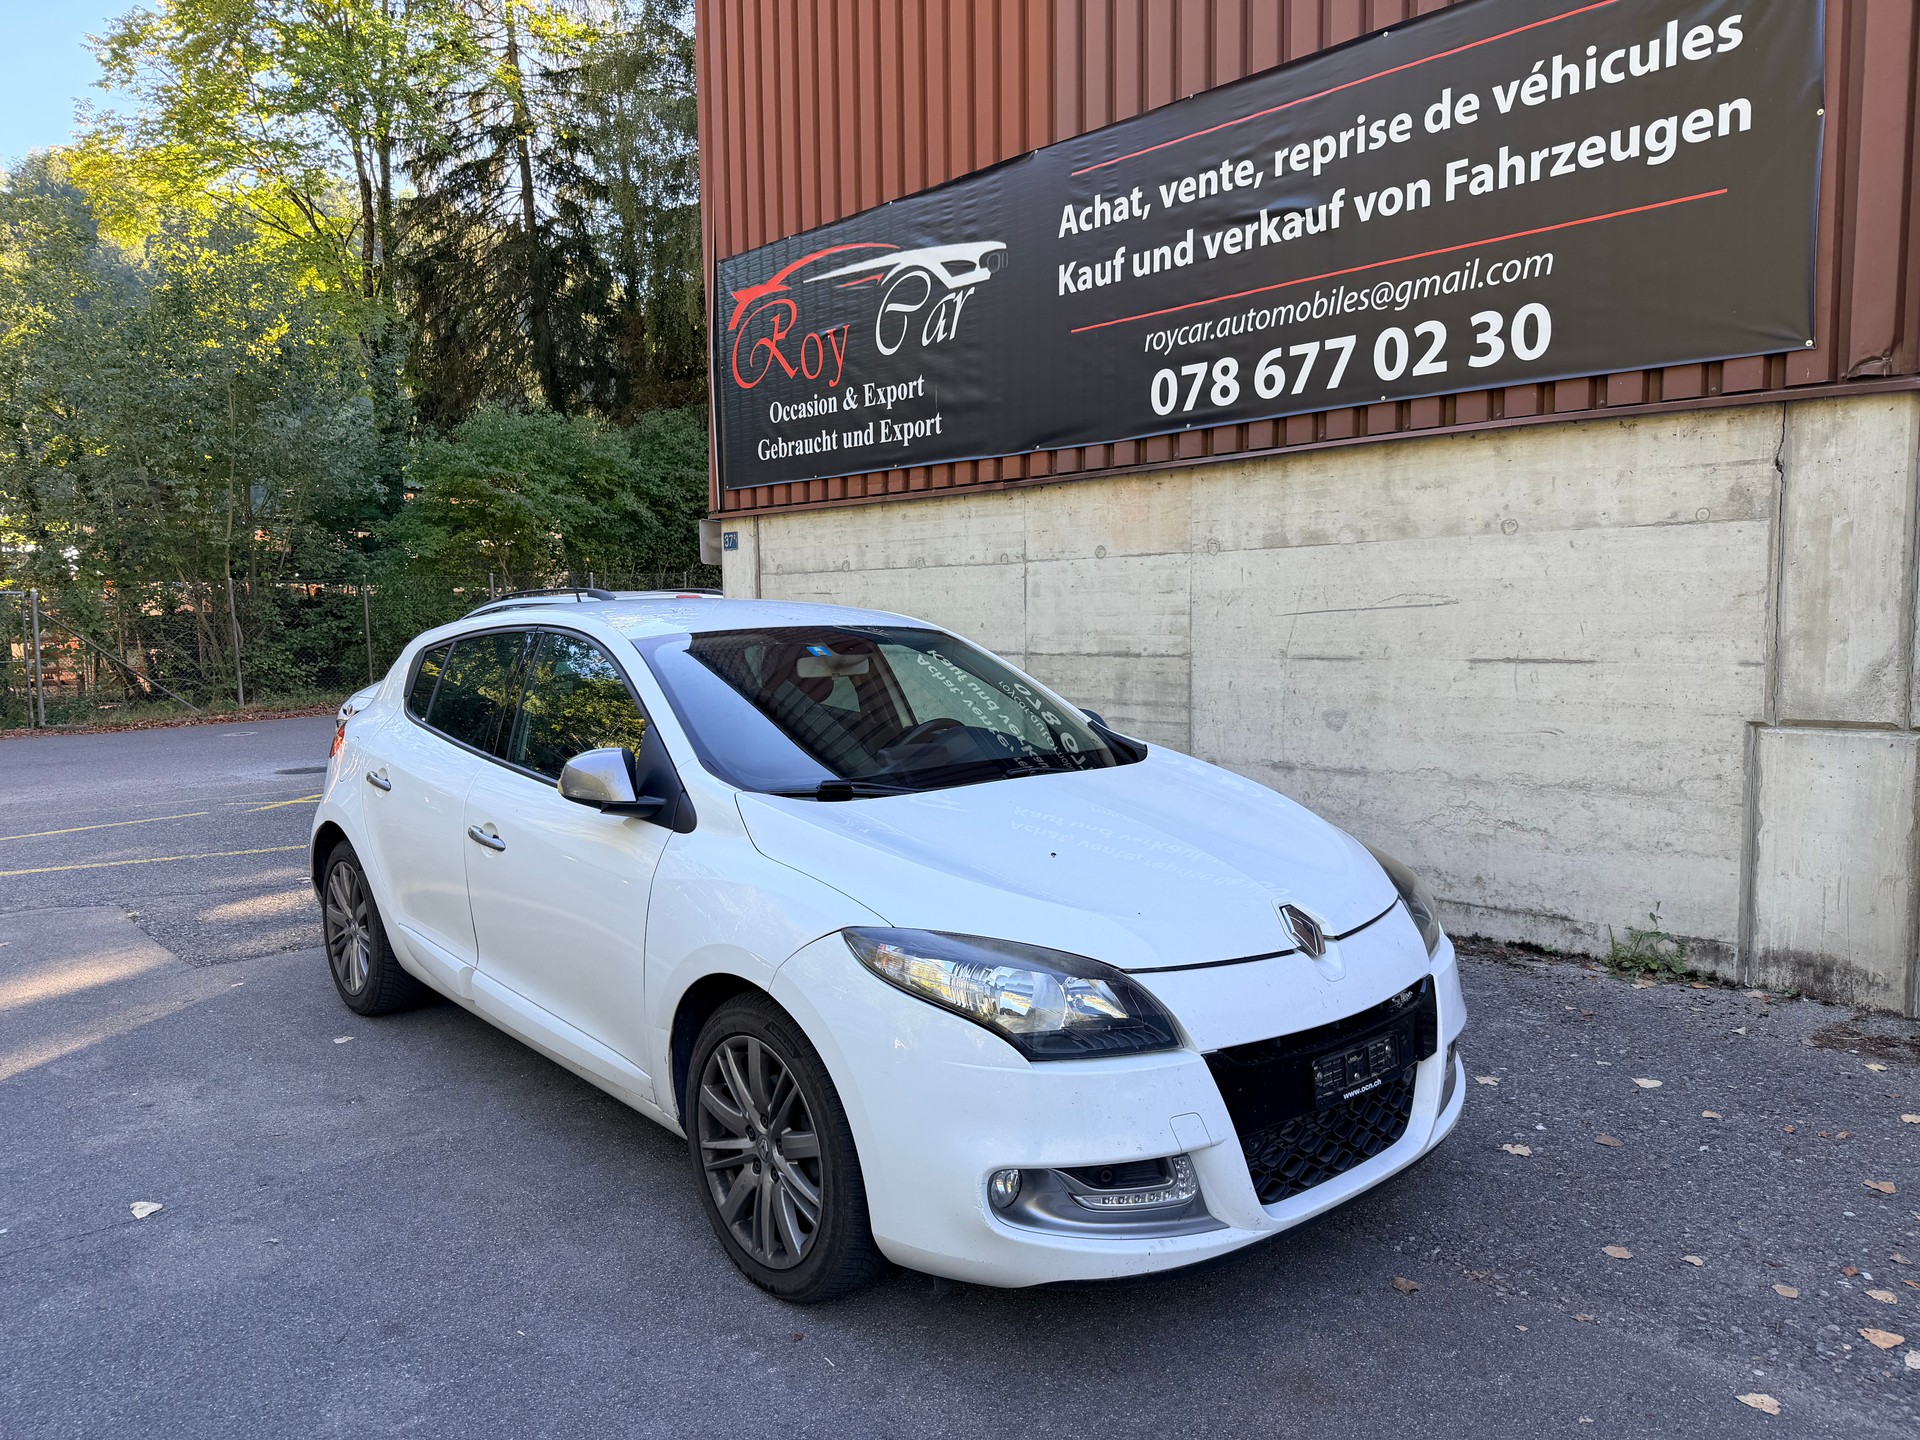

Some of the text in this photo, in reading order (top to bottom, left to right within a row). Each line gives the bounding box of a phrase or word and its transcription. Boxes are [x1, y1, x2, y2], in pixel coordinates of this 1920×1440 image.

[1058, 14, 1744, 239] Achat, vente, reprise de véhicules
[1058, 97, 1752, 297] Kauf und verkauf von Fahrzeugen
[732, 270, 976, 389] Roy Car
[1144, 251, 1554, 356] roycar.automobiles@gmail.com
[769, 374, 925, 424] Occasion & Export
[1150, 302, 1552, 416] 078 677 02 30
[757, 411, 943, 461] Gebraucht und Export
[1343, 1079, 1382, 1099] www.ocn.ch
